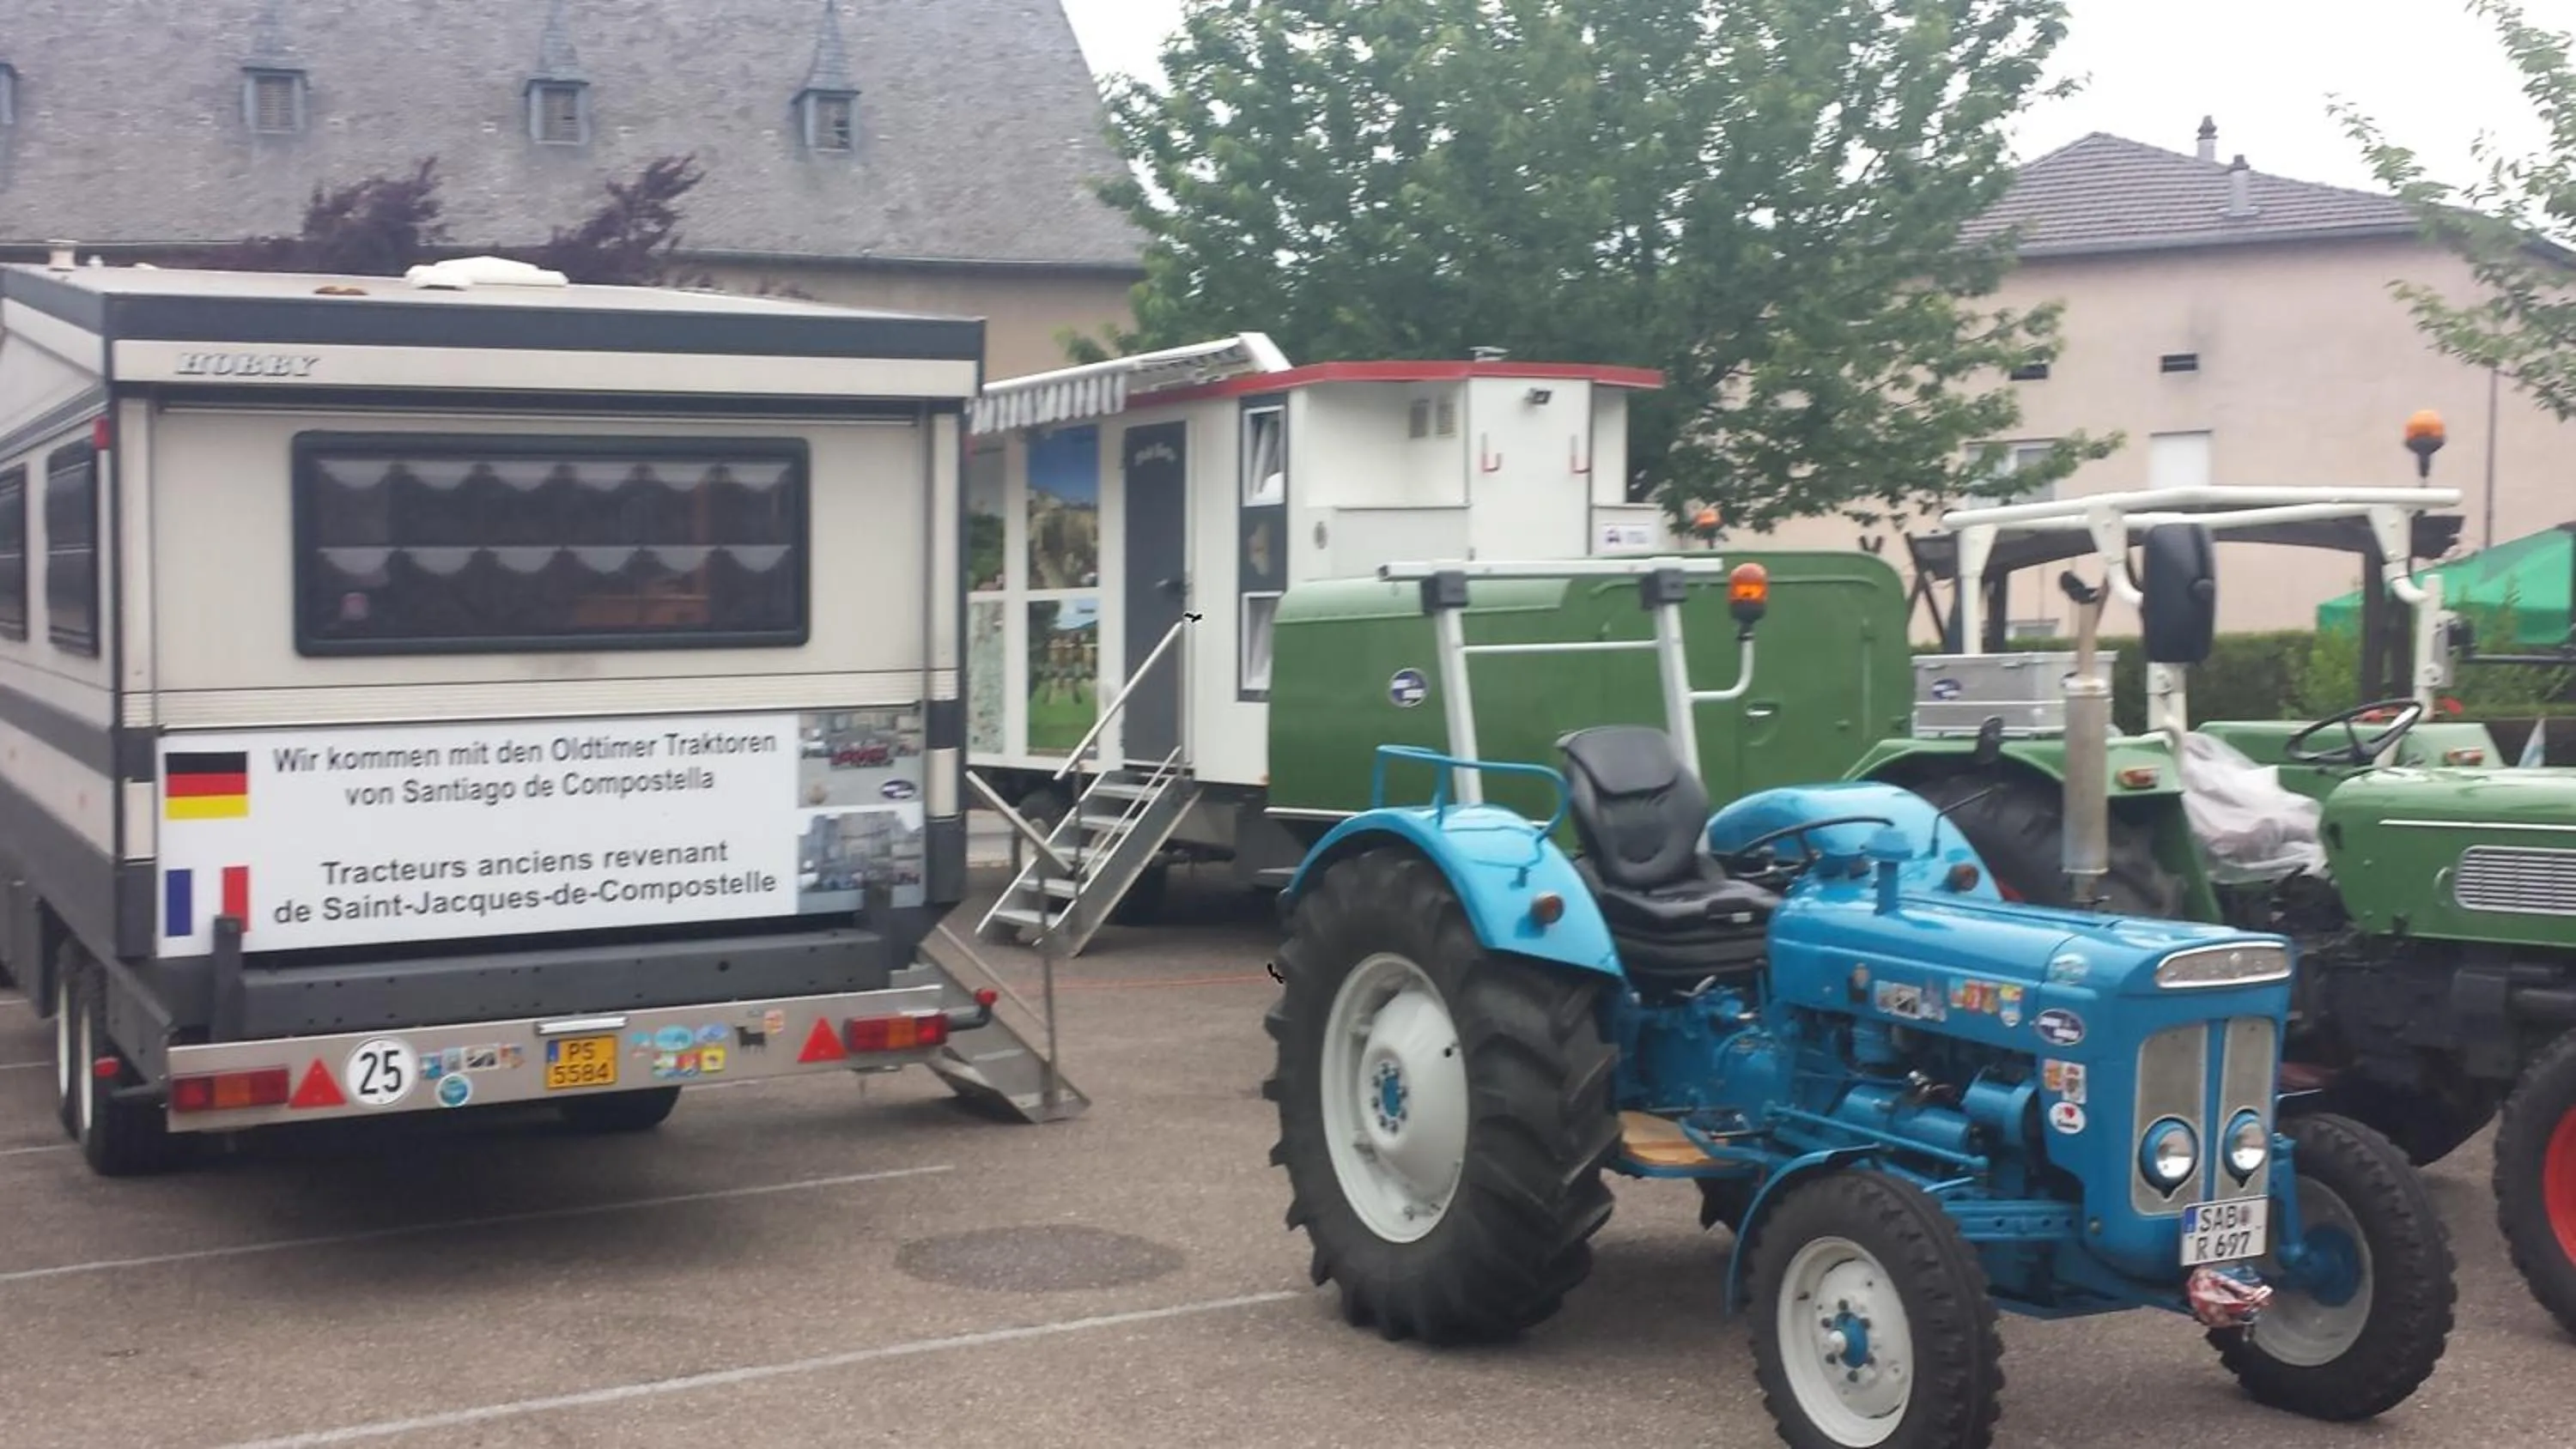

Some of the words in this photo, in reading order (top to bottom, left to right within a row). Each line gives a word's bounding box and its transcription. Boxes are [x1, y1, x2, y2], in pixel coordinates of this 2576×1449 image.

[174, 353, 321, 376] HOBBY
[272, 747, 319, 772] Wir
[326, 746, 440, 770] kommen
[448, 741, 490, 766] mit
[496, 739, 543, 764] den
[550, 736, 658, 761] Oldtimer
[665, 732, 777, 756] Traktoren
[345, 785, 394, 805] von
[402, 778, 516, 806] Santiago
[524, 774, 554, 798] de
[562, 767, 714, 798] Compostella
[320, 859, 467, 885] Tracteurs
[478, 851, 592, 876] anciens
[604, 840, 729, 869] revenant
[274, 900, 311, 924] de
[322, 870, 776, 921] Saint-Jacques-de-Compostelle
[568, 1042, 595, 1061] PS
[358, 1050, 402, 1094] 25
[554, 1064, 609, 1083] 5584
[2201, 1205, 2237, 1232] SAB
[2196, 1236, 2208, 1261] R
[2215, 1231, 2251, 1258] 697
